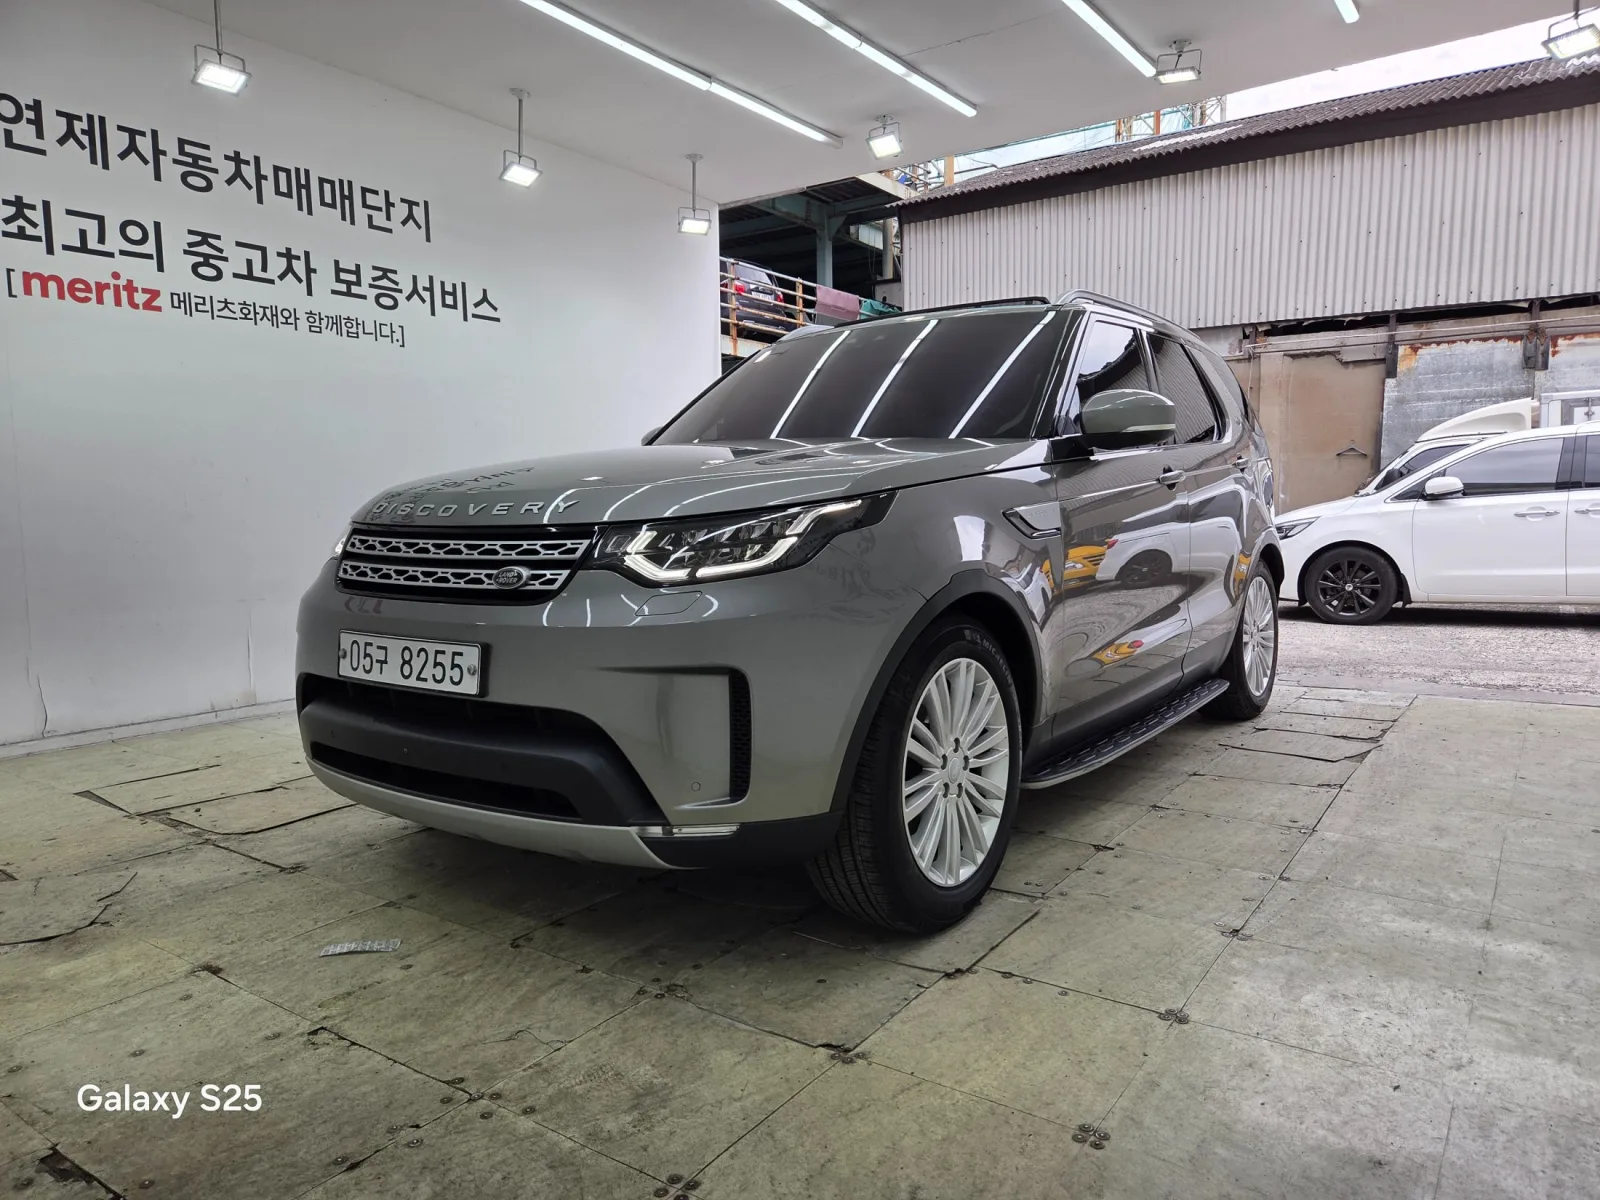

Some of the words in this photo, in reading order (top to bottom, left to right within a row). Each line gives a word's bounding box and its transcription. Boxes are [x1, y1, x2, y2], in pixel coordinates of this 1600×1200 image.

[0, 92, 432, 242] 연제자동차매매단지
[1, 194, 165, 272] 최고의
[182, 228, 318, 297] 중고차
[330, 258, 502, 323] 보증서비스
[170, 291, 301, 331] 메리츠화재와
[371, 500, 580, 517] DISCOVERY
[350, 639, 389, 676] 05구
[399, 645, 465, 686] 8255
